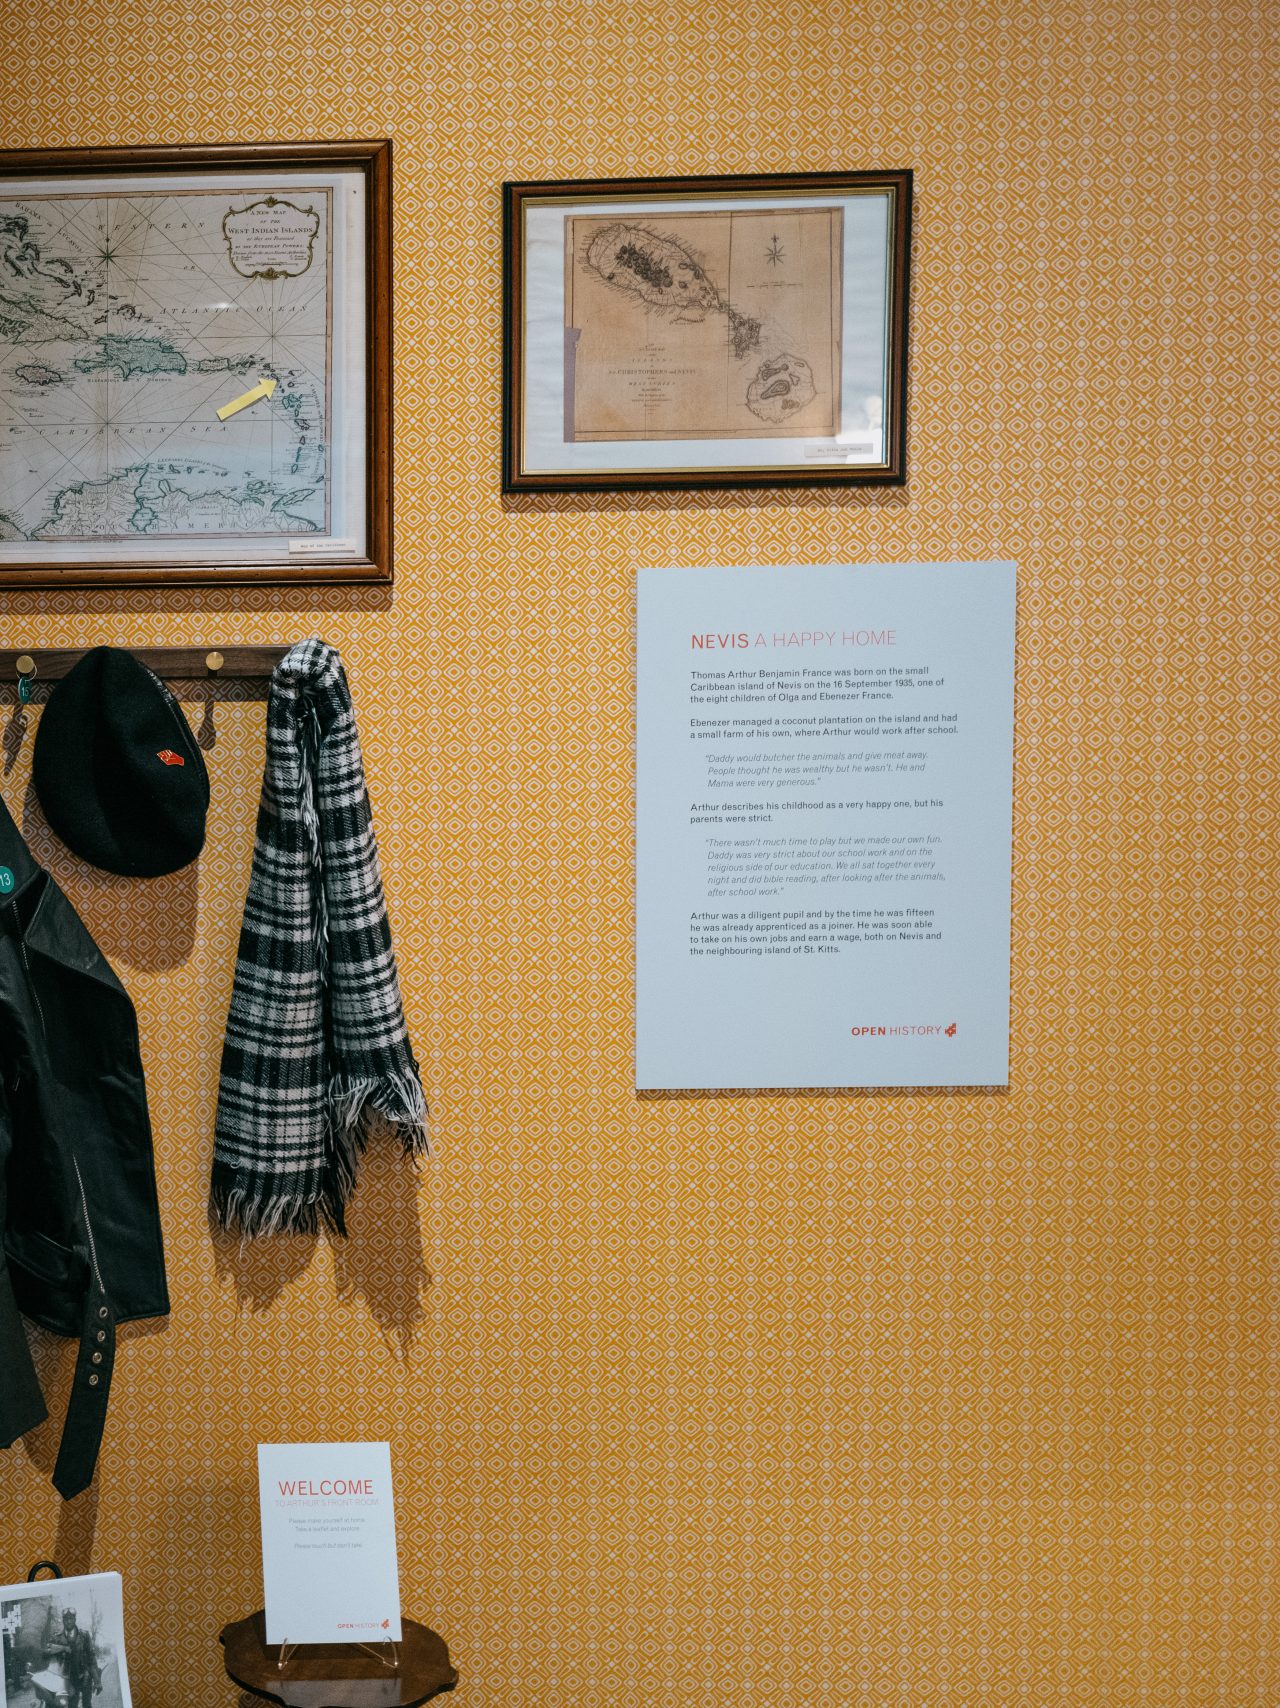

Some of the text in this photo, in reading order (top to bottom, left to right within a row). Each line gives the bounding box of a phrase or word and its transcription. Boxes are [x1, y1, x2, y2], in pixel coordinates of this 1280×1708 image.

[692, 631, 895, 649] NEVIS A HAPPY HOME
[691, 671, 726, 679] Thomas
[728, 670, 756, 679] Arthur
[759, 670, 800, 679] Benjamin
[803, 669, 832, 677] France
[889, 667, 903, 675] the
[905, 666, 929, 675] small
[691, 683, 735, 692] Caribbean
[738, 682, 764, 691] island
[766, 681, 775, 690] of
[777, 681, 802, 690] Nevis
[817, 681, 831, 689] the
[833, 680, 842, 688] 16
[845, 680, 892, 689] September
[895, 679, 914, 688] 1935,
[936, 677, 944, 686] of
[690, 691, 893, 704] the eight children of Olga and Ebenezer France.
[690, 719, 730, 727] Ebenezer
[733, 718, 772, 727] managed
[782, 717, 816, 725] coconut
[819, 716, 862, 725] plantation
[878, 715, 892, 723] the
[895, 715, 920, 723] island
[923, 714, 939, 722] and
[942, 714, 958, 722] had
[698, 730, 721, 739] small
[723, 730, 744, 738] farm
[746, 729, 754, 738] of
[757, 729, 770, 738] his
[822, 728, 851, 736] Arthur
[854, 727, 880, 736] would
[882, 727, 902, 735] work
[905, 726, 925, 735] after
[928, 726, 958, 734] school.
[708, 765, 736, 776] People
[738, 766, 770, 776] thought
[785, 767, 801, 775] was
[802, 765, 834, 775] wealthy
[836, 764, 850, 774] but
[864, 762, 893, 773] wasn't.
[909, 763, 926, 772] and
[691, 803, 719, 811] Arthur
[722, 803, 764, 811] describes
[766, 802, 779, 810] his
[782, 801, 824, 810] childhood
[866, 801, 891, 810] happy
[690, 816, 723, 824] parents
[748, 814, 773, 822] strict.
[748, 911, 780, 920] diligent
[783, 910, 804, 920] pupil
[806, 910, 822, 918] and
[825, 910, 834, 920] by
[852, 910, 872, 918] time
[874, 909, 884, 917] he
[906, 908, 934, 917] fifteen
[690, 924, 701, 932] he
[722, 923, 754, 932] already
[756, 922, 806, 932] apprenticed
[829, 922, 854, 931] joiner.
[857, 921, 870, 929] He
[914, 920, 933, 928] able
[701, 935, 719, 944] take
[770, 934, 788, 944] jobs
[790, 934, 806, 942] and
[837, 935, 862, 943] wage,
[864, 932, 884, 941] both
[899, 932, 924, 940] Nevis
[926, 932, 942, 940] and
[690, 945, 840, 956] the neighbouring island of St. Kitts.
[851, 1026, 941, 1036] OPEN HISTORY
[278, 1480, 373, 1496] WELCOME
